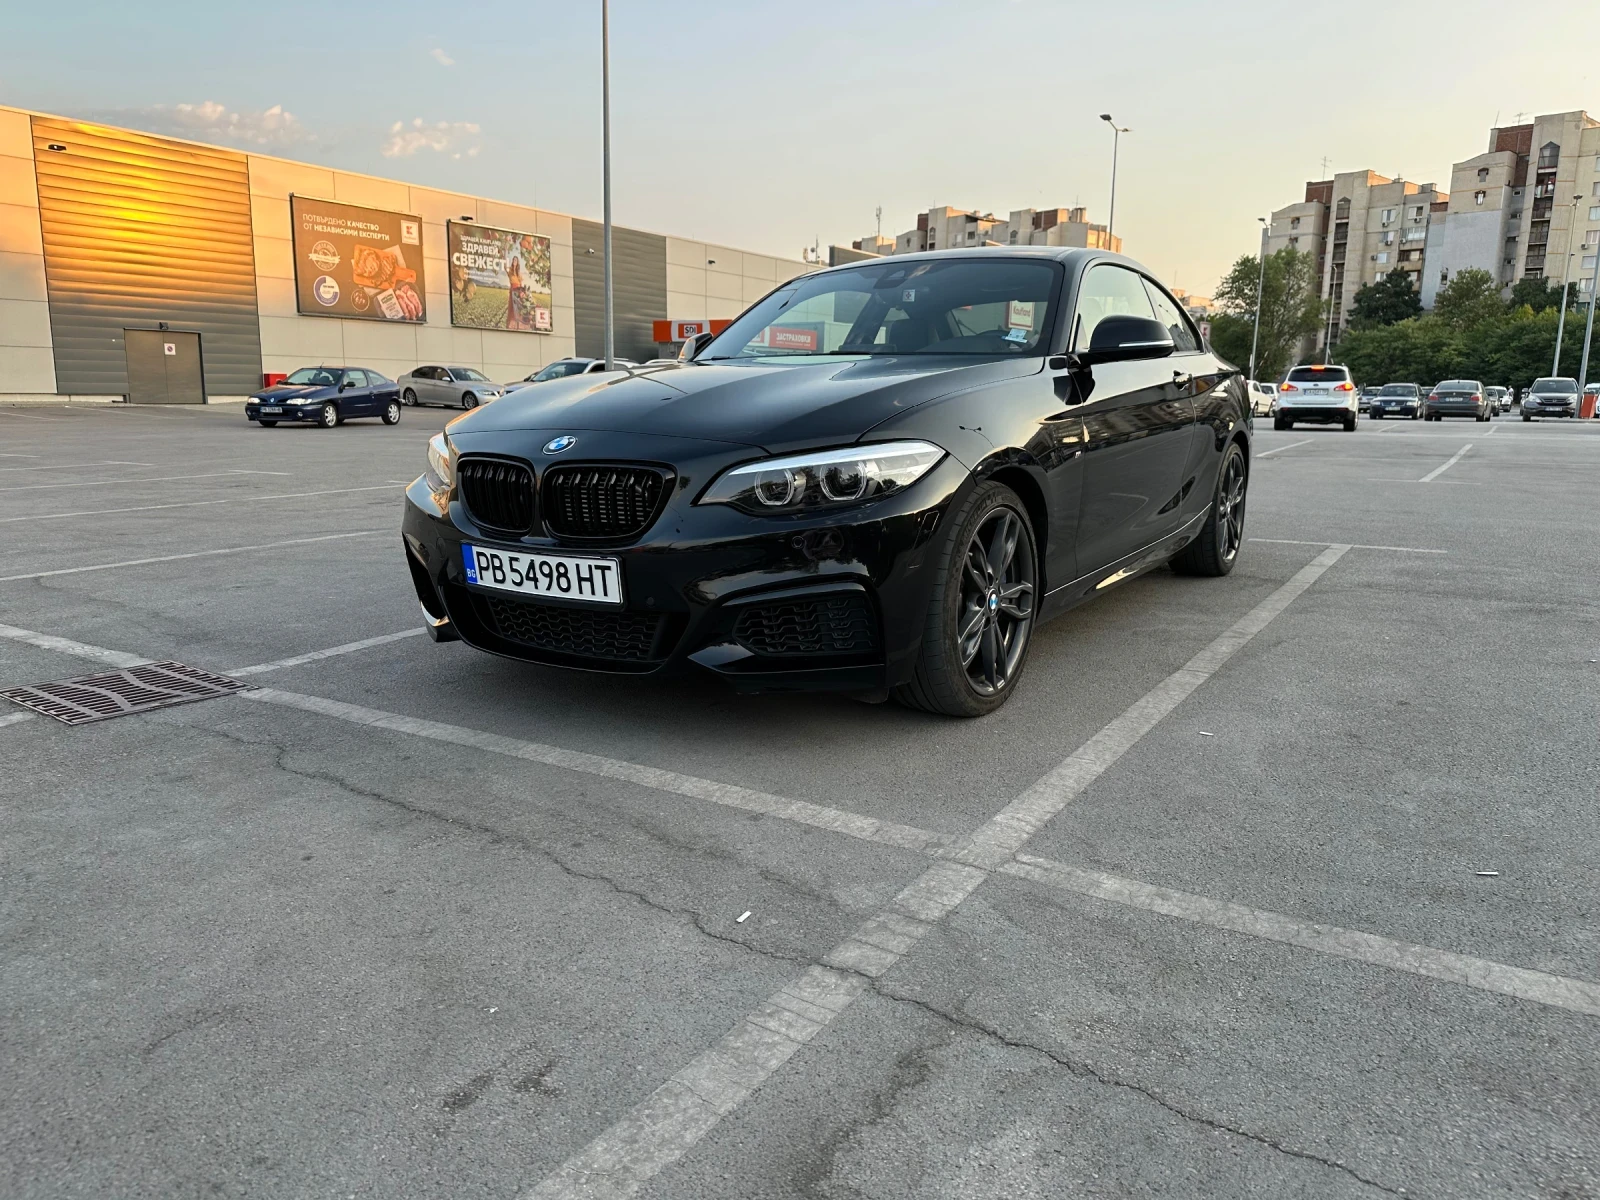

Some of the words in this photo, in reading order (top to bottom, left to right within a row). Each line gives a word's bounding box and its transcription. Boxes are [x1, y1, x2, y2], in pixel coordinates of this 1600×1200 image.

[303, 214, 346, 225] ПОТВЪРДЕНО
[347, 220, 379, 231] КАЧЕСТВО
[314, 224, 358, 237] НЕЗАВИСИМИ
[359, 231, 390, 241] ЕКСПЕРТИ
[462, 242, 500, 257] ЗДРАВЕЙ,
[453, 252, 510, 272] СВЕЖЕСТ!
[776, 332, 811, 342] ЗАСТРАХОВКИ
[466, 568, 476, 578] BG
